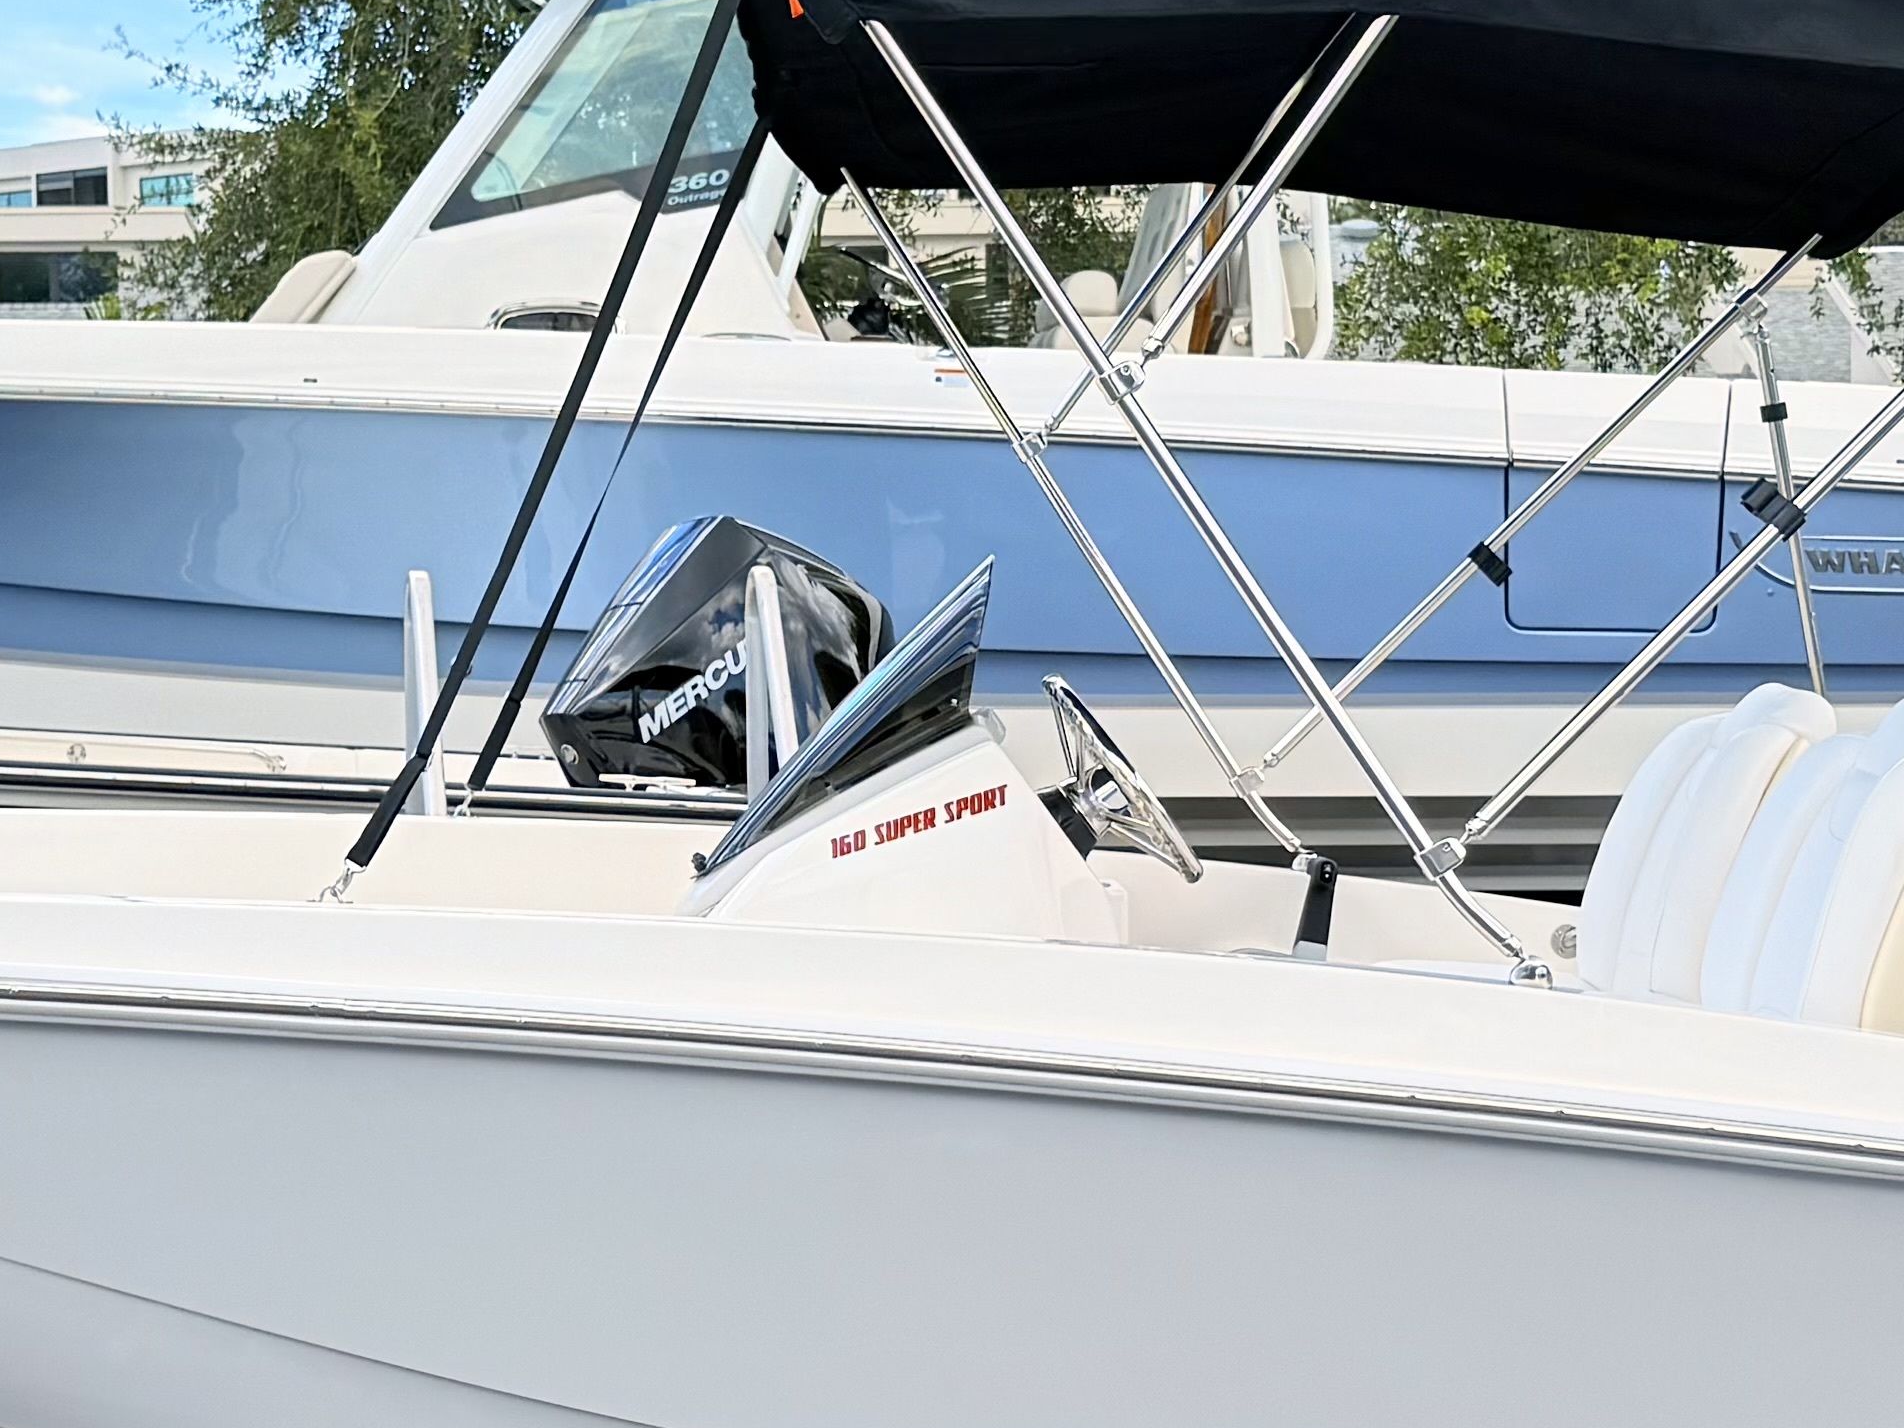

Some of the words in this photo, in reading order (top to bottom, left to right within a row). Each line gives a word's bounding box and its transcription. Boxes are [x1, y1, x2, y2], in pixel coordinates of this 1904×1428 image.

[668, 169, 730, 194] 360
[638, 638, 747, 744] MERCU
[830, 829, 867, 859] 160
[874, 807, 937, 846] SUPER
[944, 784, 1008, 824] SPORT
